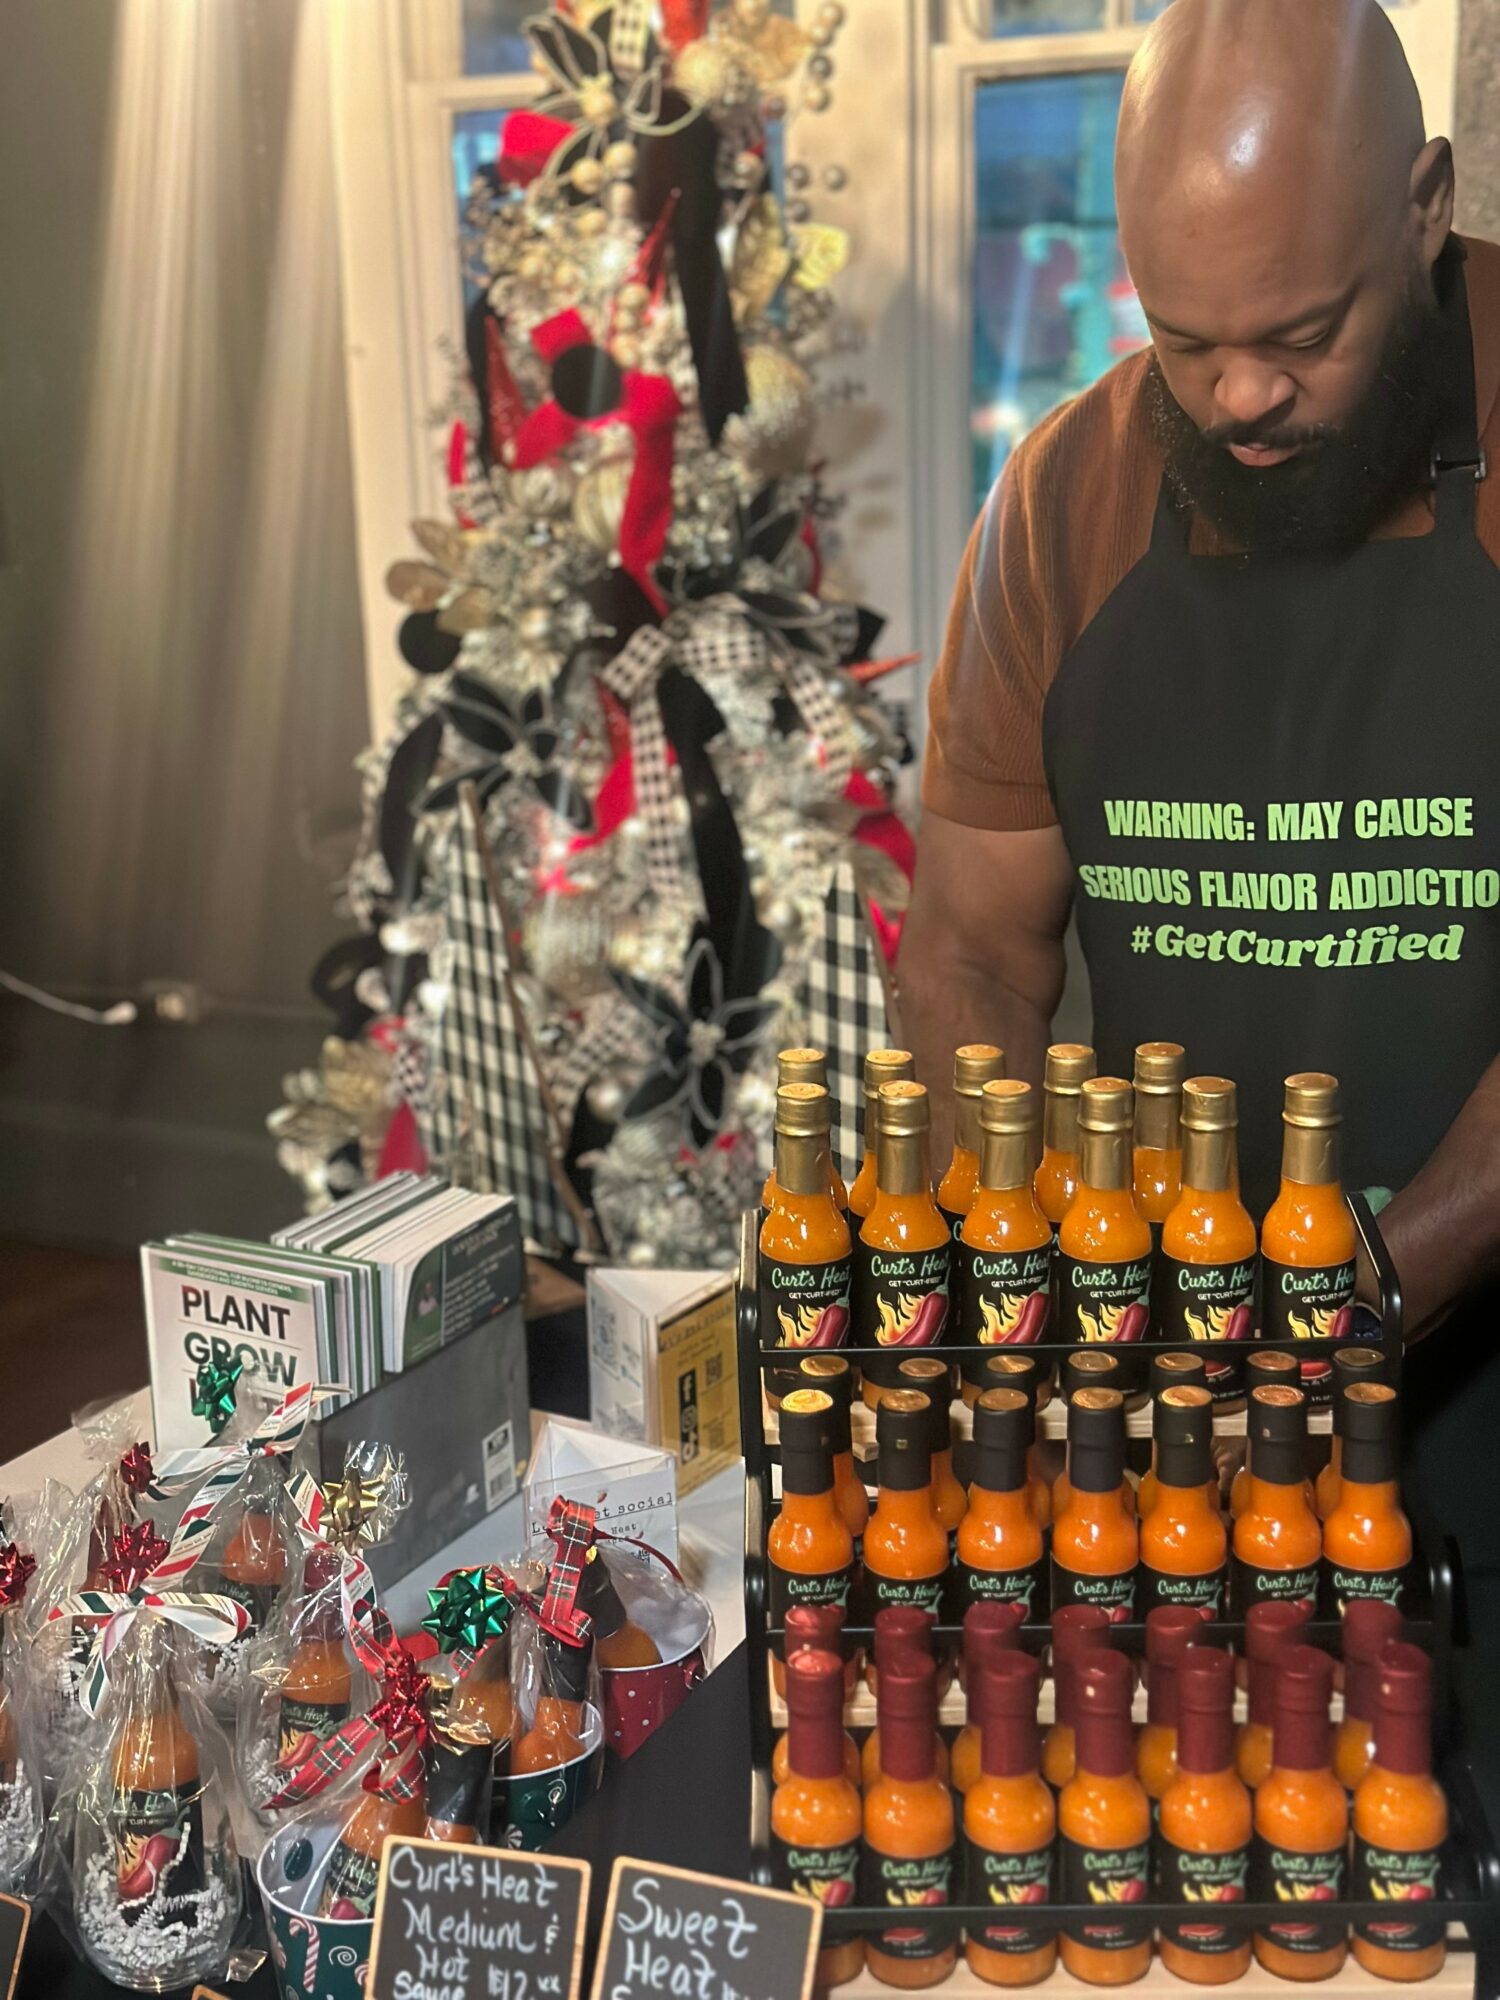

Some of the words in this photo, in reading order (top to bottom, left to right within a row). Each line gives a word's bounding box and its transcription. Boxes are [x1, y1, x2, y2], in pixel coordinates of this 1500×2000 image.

[1103, 799, 1256, 841] WARNING:
[1267, 800, 1344, 841] MAY
[1354, 797, 1474, 839] CAUSE
[1078, 864, 1192, 906] SERIOUS
[1199, 869, 1319, 912] FLAVOR
[1130, 923, 1466, 968] #GetCurtified
[871, 1255, 915, 1277] Curt's
[973, 1256, 1018, 1278] Curt's
[1072, 1266, 1117, 1288] Curt's
[772, 1267, 816, 1289] Curt's
[991, 1280, 1004, 1288] GET
[1178, 1268, 1225, 1291] Curt's
[1281, 1271, 1329, 1294] Curt's
[1090, 1290, 1103, 1298] GET
[1197, 1293, 1211, 1301] GET
[1302, 1295, 1315, 1304] GET
[180, 1285, 291, 1340] PLANT
[183, 1331, 297, 1387] GROW
[594, 1506, 611, 1519] et
[618, 1491, 673, 1515] social
[788, 1578, 821, 1594] Curt's
[878, 1583, 910, 1598] Curt's
[970, 1574, 1001, 1590] Curt's
[1075, 1580, 1108, 1596] Curt's
[1158, 1580, 1191, 1595] Curt's
[1257, 1575, 1291, 1591] Curt's
[1334, 1572, 1366, 1589] Curt's
[389, 1845, 475, 1893] Curt's
[481, 1859, 559, 1909] Heat
[402, 1897, 537, 1954] Medium
[617, 1877, 758, 1959] Sweet
[415, 1943, 470, 1983] Hot
[624, 1937, 716, 2000] Heat
[393, 1970, 466, 2000] Sauce
